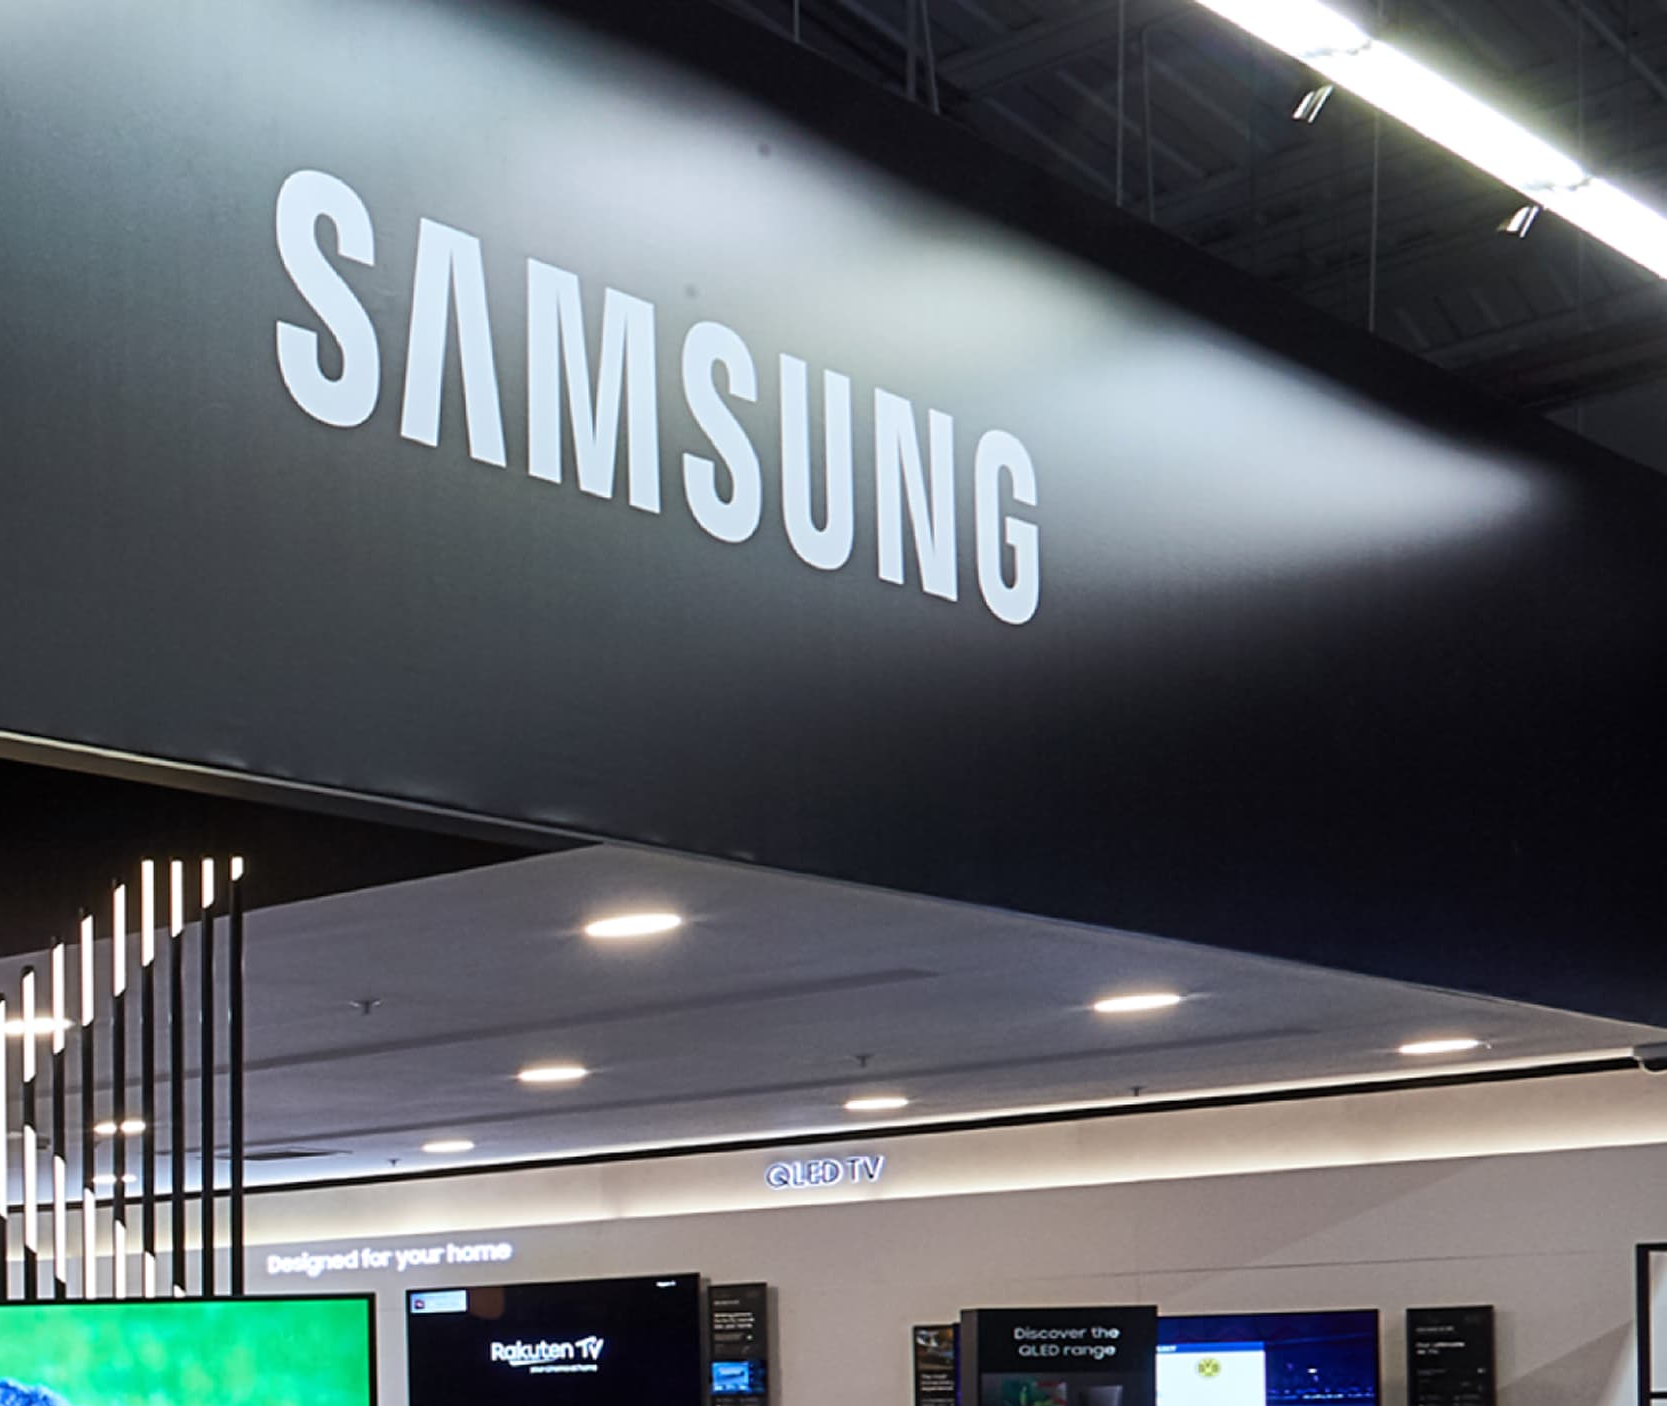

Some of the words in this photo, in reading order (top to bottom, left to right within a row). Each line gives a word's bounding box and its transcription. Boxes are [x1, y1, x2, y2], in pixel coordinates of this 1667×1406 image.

[275, 169, 1041, 625] SAMSUNG
[765, 1160, 842, 1188] QLED
[847, 1156, 884, 1183] TV
[268, 1250, 358, 1278] Designed
[362, 1248, 393, 1269] for
[396, 1245, 444, 1271] your
[446, 1242, 512, 1263] home
[1014, 1326, 1087, 1339] Discover
[1091, 1327, 1120, 1339] the
[491, 1340, 574, 1361] Rakuten
[575, 1335, 604, 1360] TV
[1019, 1344, 1060, 1356] QLED
[1063, 1345, 1116, 1360] range
